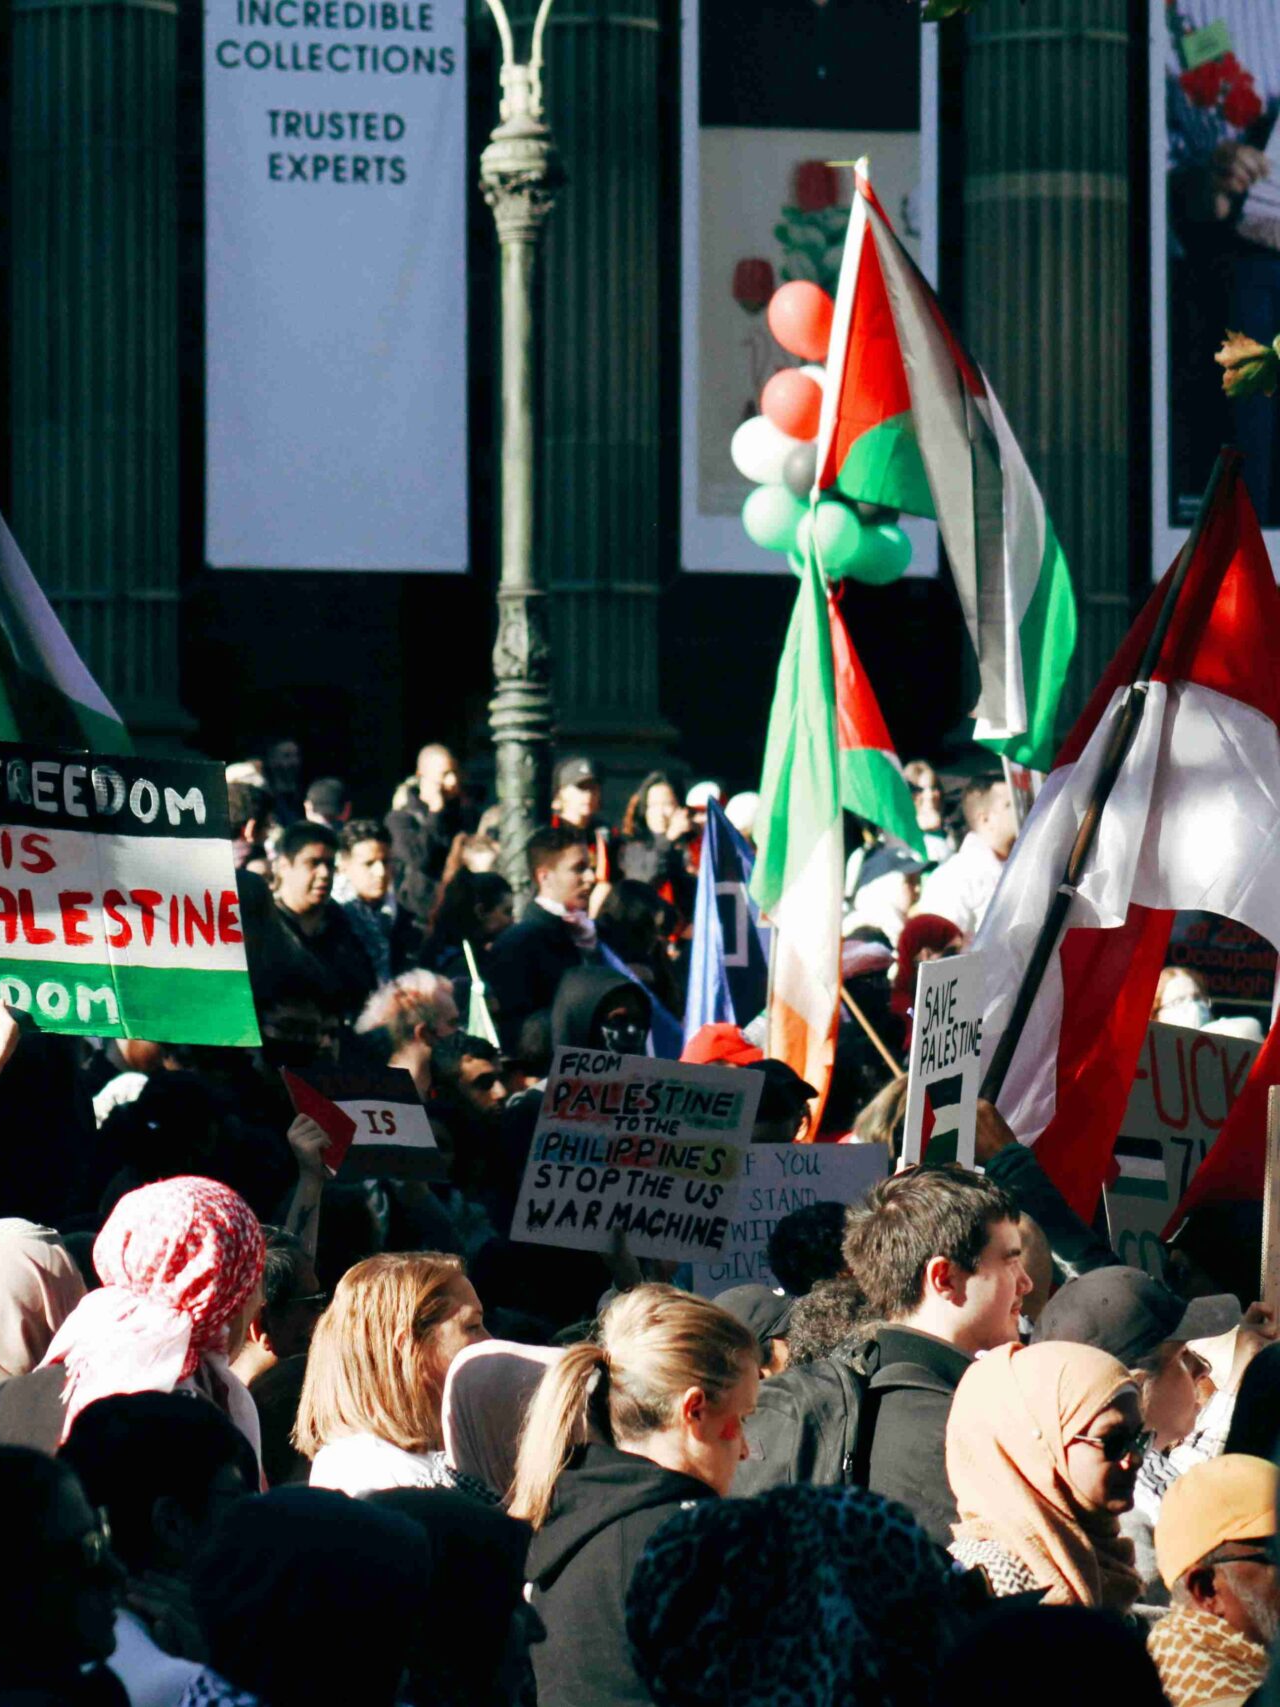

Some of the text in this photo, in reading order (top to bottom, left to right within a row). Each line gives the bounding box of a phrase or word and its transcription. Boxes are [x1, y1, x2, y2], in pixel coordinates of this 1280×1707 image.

[237, 0, 433, 31] INCREDIBLE
[215, 39, 456, 76] COLLECTIONS
[267, 109, 406, 142] TRUSTED
[268, 152, 407, 184] EXPERTS
[0, 830, 56, 874] IS
[922, 977, 958, 1032] SAVE
[559, 1052, 621, 1078] FROM
[920, 1017, 983, 1078] PALESTINE
[1136, 1030, 1252, 1131] UCK
[552, 1081, 735, 1118] PALESTINE
[360, 1109, 397, 1136] IS
[615, 1115, 681, 1136] TO THE
[541, 1132, 726, 1177] PHILIPPINES
[775, 1151, 821, 1177] YOU
[534, 1163, 724, 1210] STOP THE US
[526, 1198, 728, 1250] WAR MACHINE
